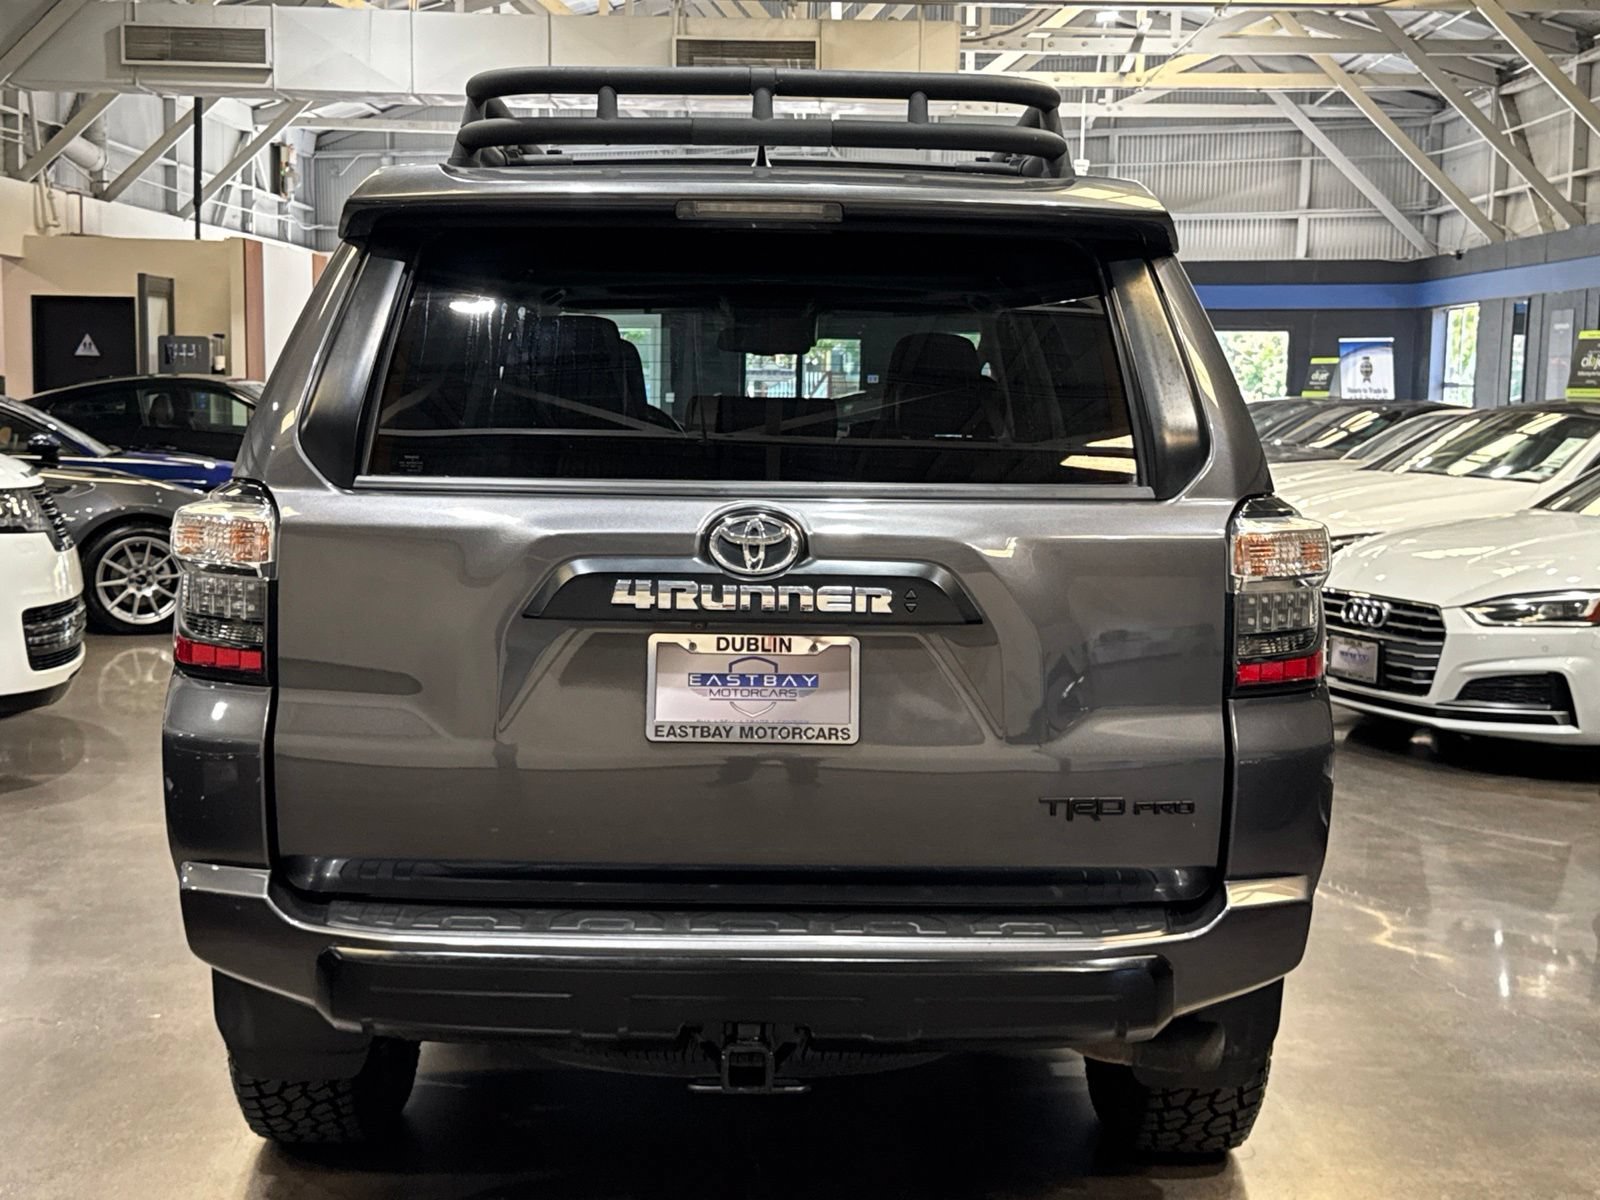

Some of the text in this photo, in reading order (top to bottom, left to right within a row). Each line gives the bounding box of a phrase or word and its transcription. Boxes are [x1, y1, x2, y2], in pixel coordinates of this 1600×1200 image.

[716, 636, 792, 653] DUBLIN
[689, 674, 817, 687] EASTBAY
[709, 688, 798, 698] MOTORCARS
[654, 725, 851, 741] EASTBAY MOTORCARS
[1039, 797, 1195, 821] TRD PRO
